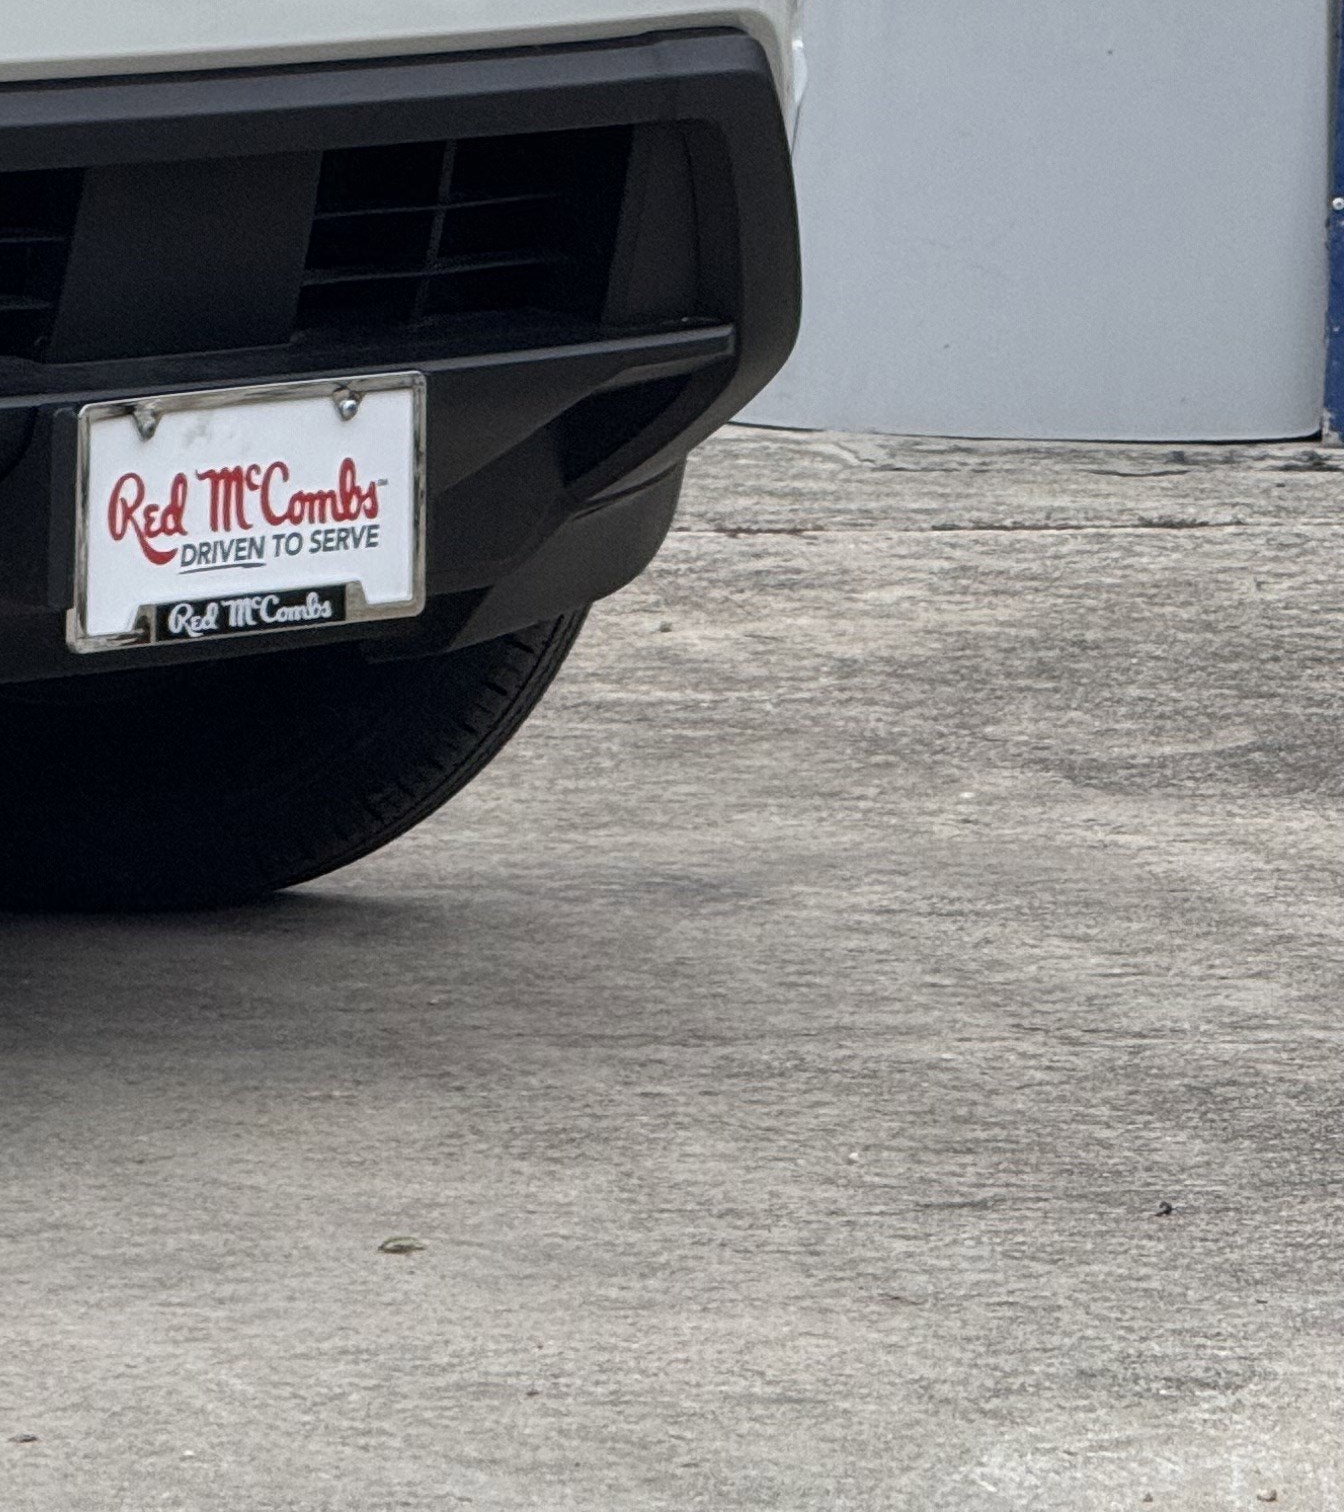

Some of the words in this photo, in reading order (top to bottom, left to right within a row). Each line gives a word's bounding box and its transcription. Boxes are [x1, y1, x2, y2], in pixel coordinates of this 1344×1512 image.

[107, 472, 188, 565] Red
[195, 457, 379, 533] McCombs
[180, 535, 266, 568] DRIVEN
[274, 532, 304, 558] TO
[311, 524, 380, 554] SERVE
[168, 602, 218, 637] Red
[220, 591, 333, 628] McCombs
